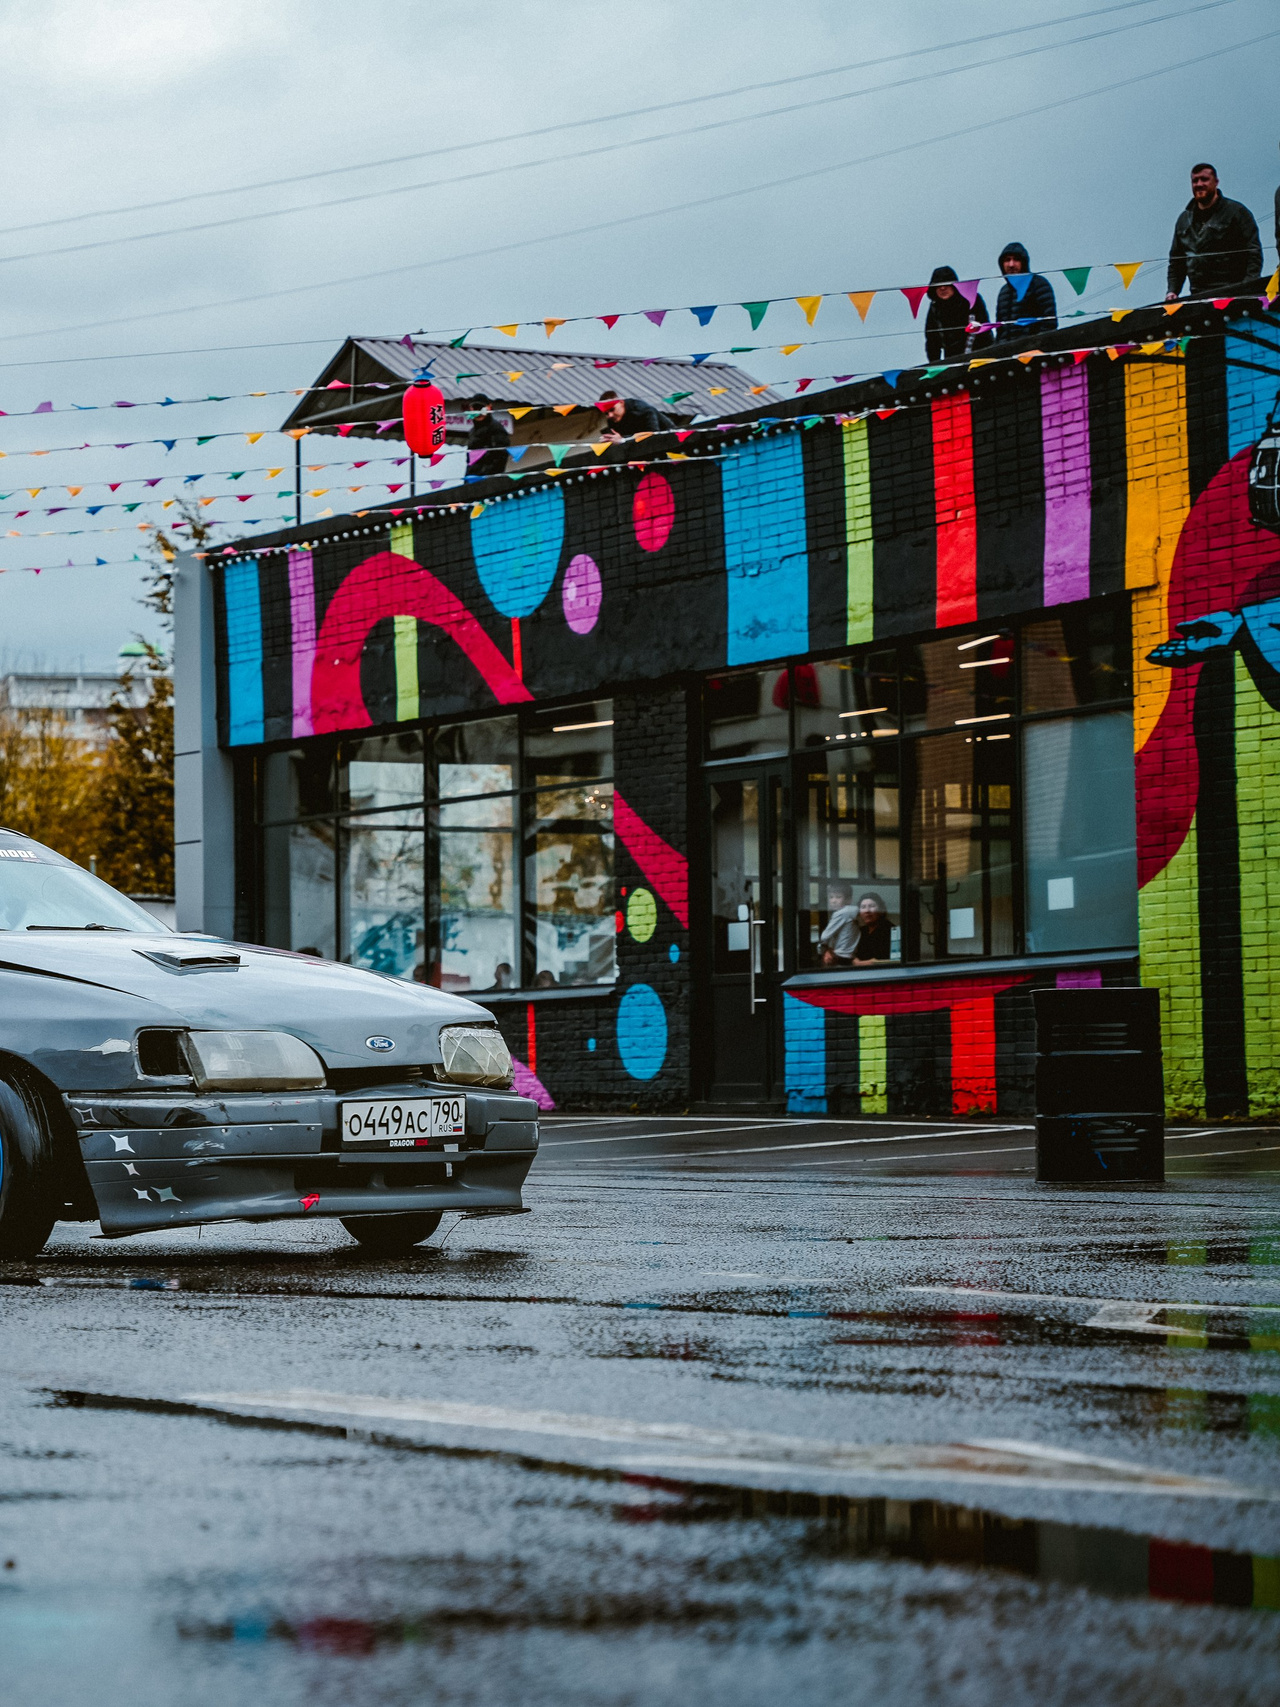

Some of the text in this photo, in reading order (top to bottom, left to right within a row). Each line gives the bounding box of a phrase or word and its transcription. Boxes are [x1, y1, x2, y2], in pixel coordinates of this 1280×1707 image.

[433, 1100, 460, 1125] 790
[438, 1124, 452, 1133] RUS
[389, 1139, 415, 1147] DRAGON
